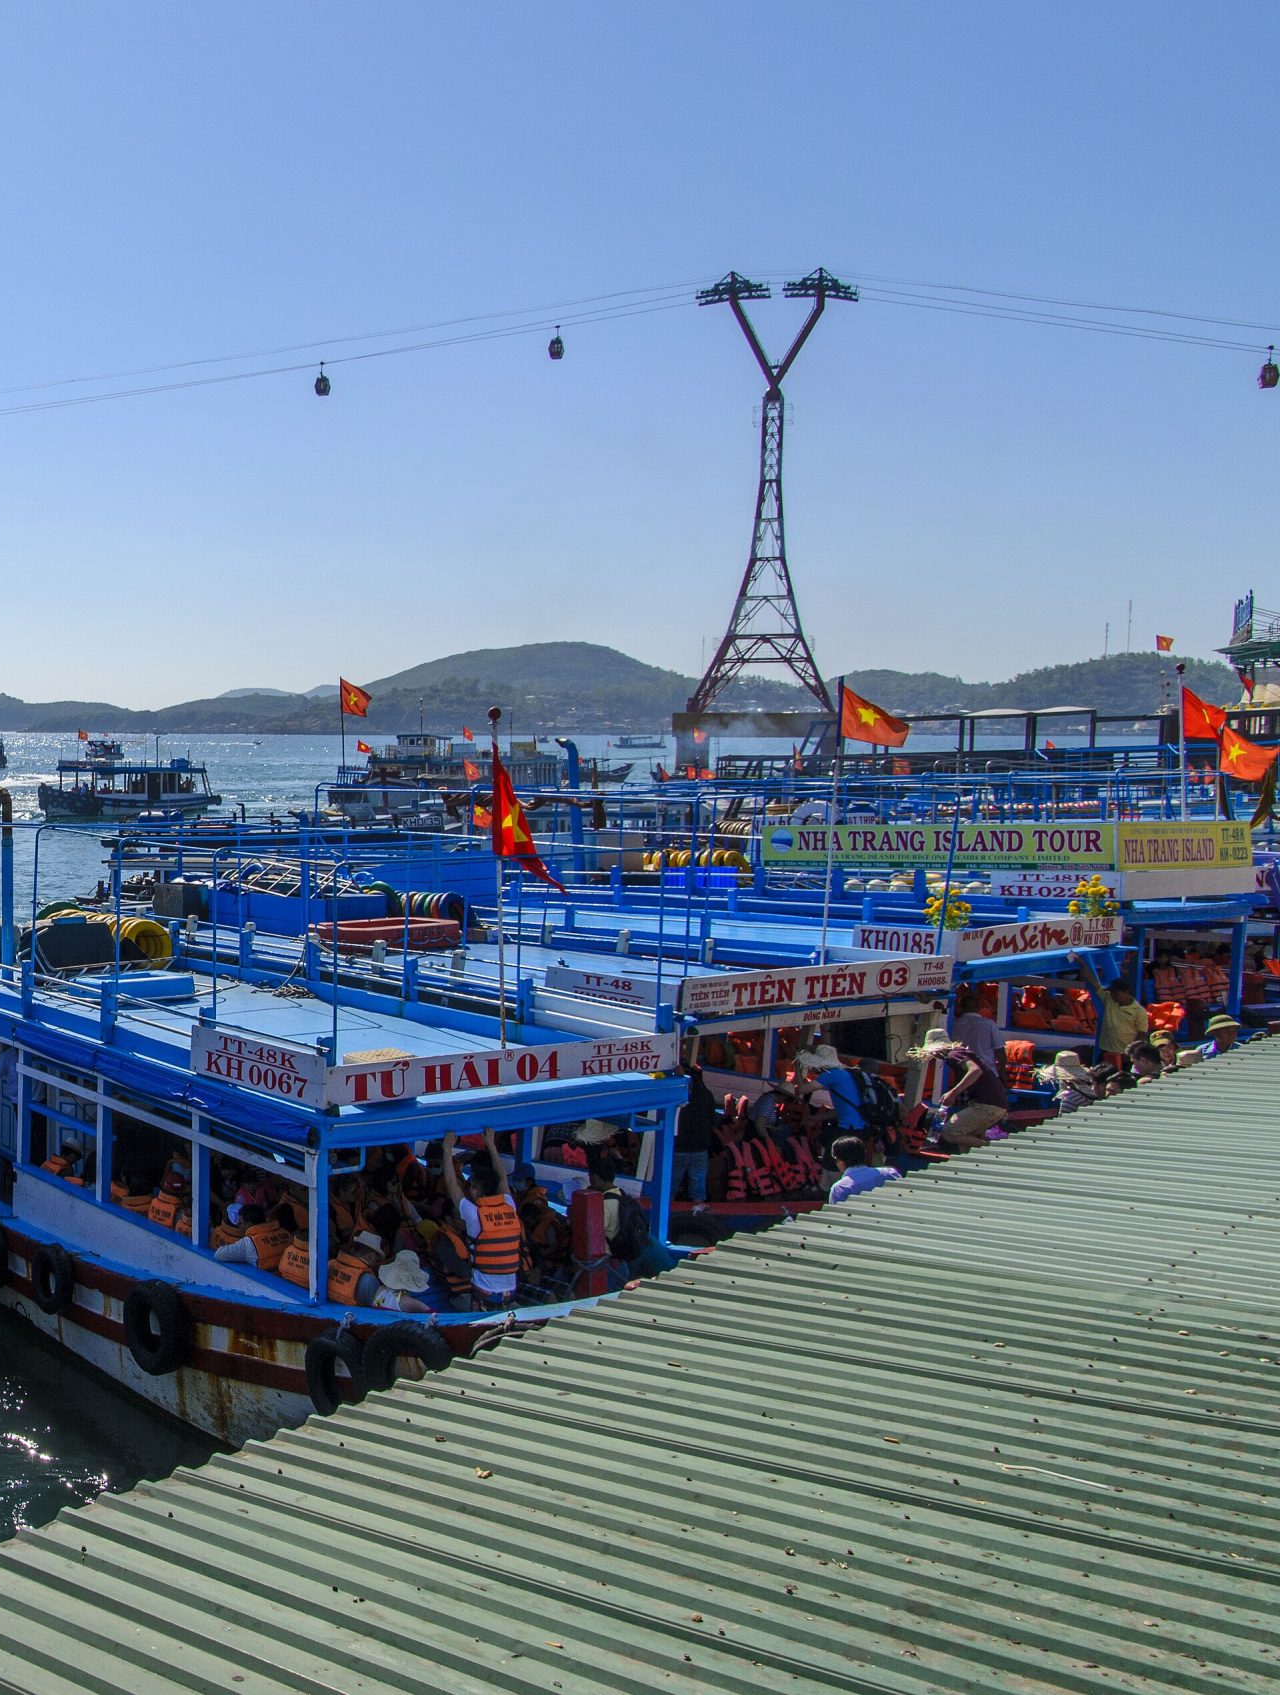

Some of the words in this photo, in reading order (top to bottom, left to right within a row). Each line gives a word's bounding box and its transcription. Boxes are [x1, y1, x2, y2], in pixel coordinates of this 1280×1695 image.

[797, 830, 843, 851] NHA
[847, 830, 926, 852] TRANG
[933, 829, 1024, 852] ISLAND
[1032, 829, 1103, 853] TOUR
[1123, 839, 1145, 864] NHA
[1147, 838, 1179, 863] TRANG
[1181, 838, 1215, 862] ISLAND
[1018, 873, 1088, 882] TT-48K
[860, 928, 935, 955] KH0185
[923, 961, 945, 972] TT-48
[583, 973, 633, 992] TT-48
[732, 974, 796, 1007] TIÊN
[804, 965, 867, 1000] TIẾN
[878, 967, 908, 988] 03
[219, 1035, 297, 1072] TT-48K
[593, 1040, 653, 1055] TT-48K
[345, 1060, 411, 1103] TỨ
[421, 1055, 502, 1094] HẢI
[516, 1050, 561, 1082] 04
